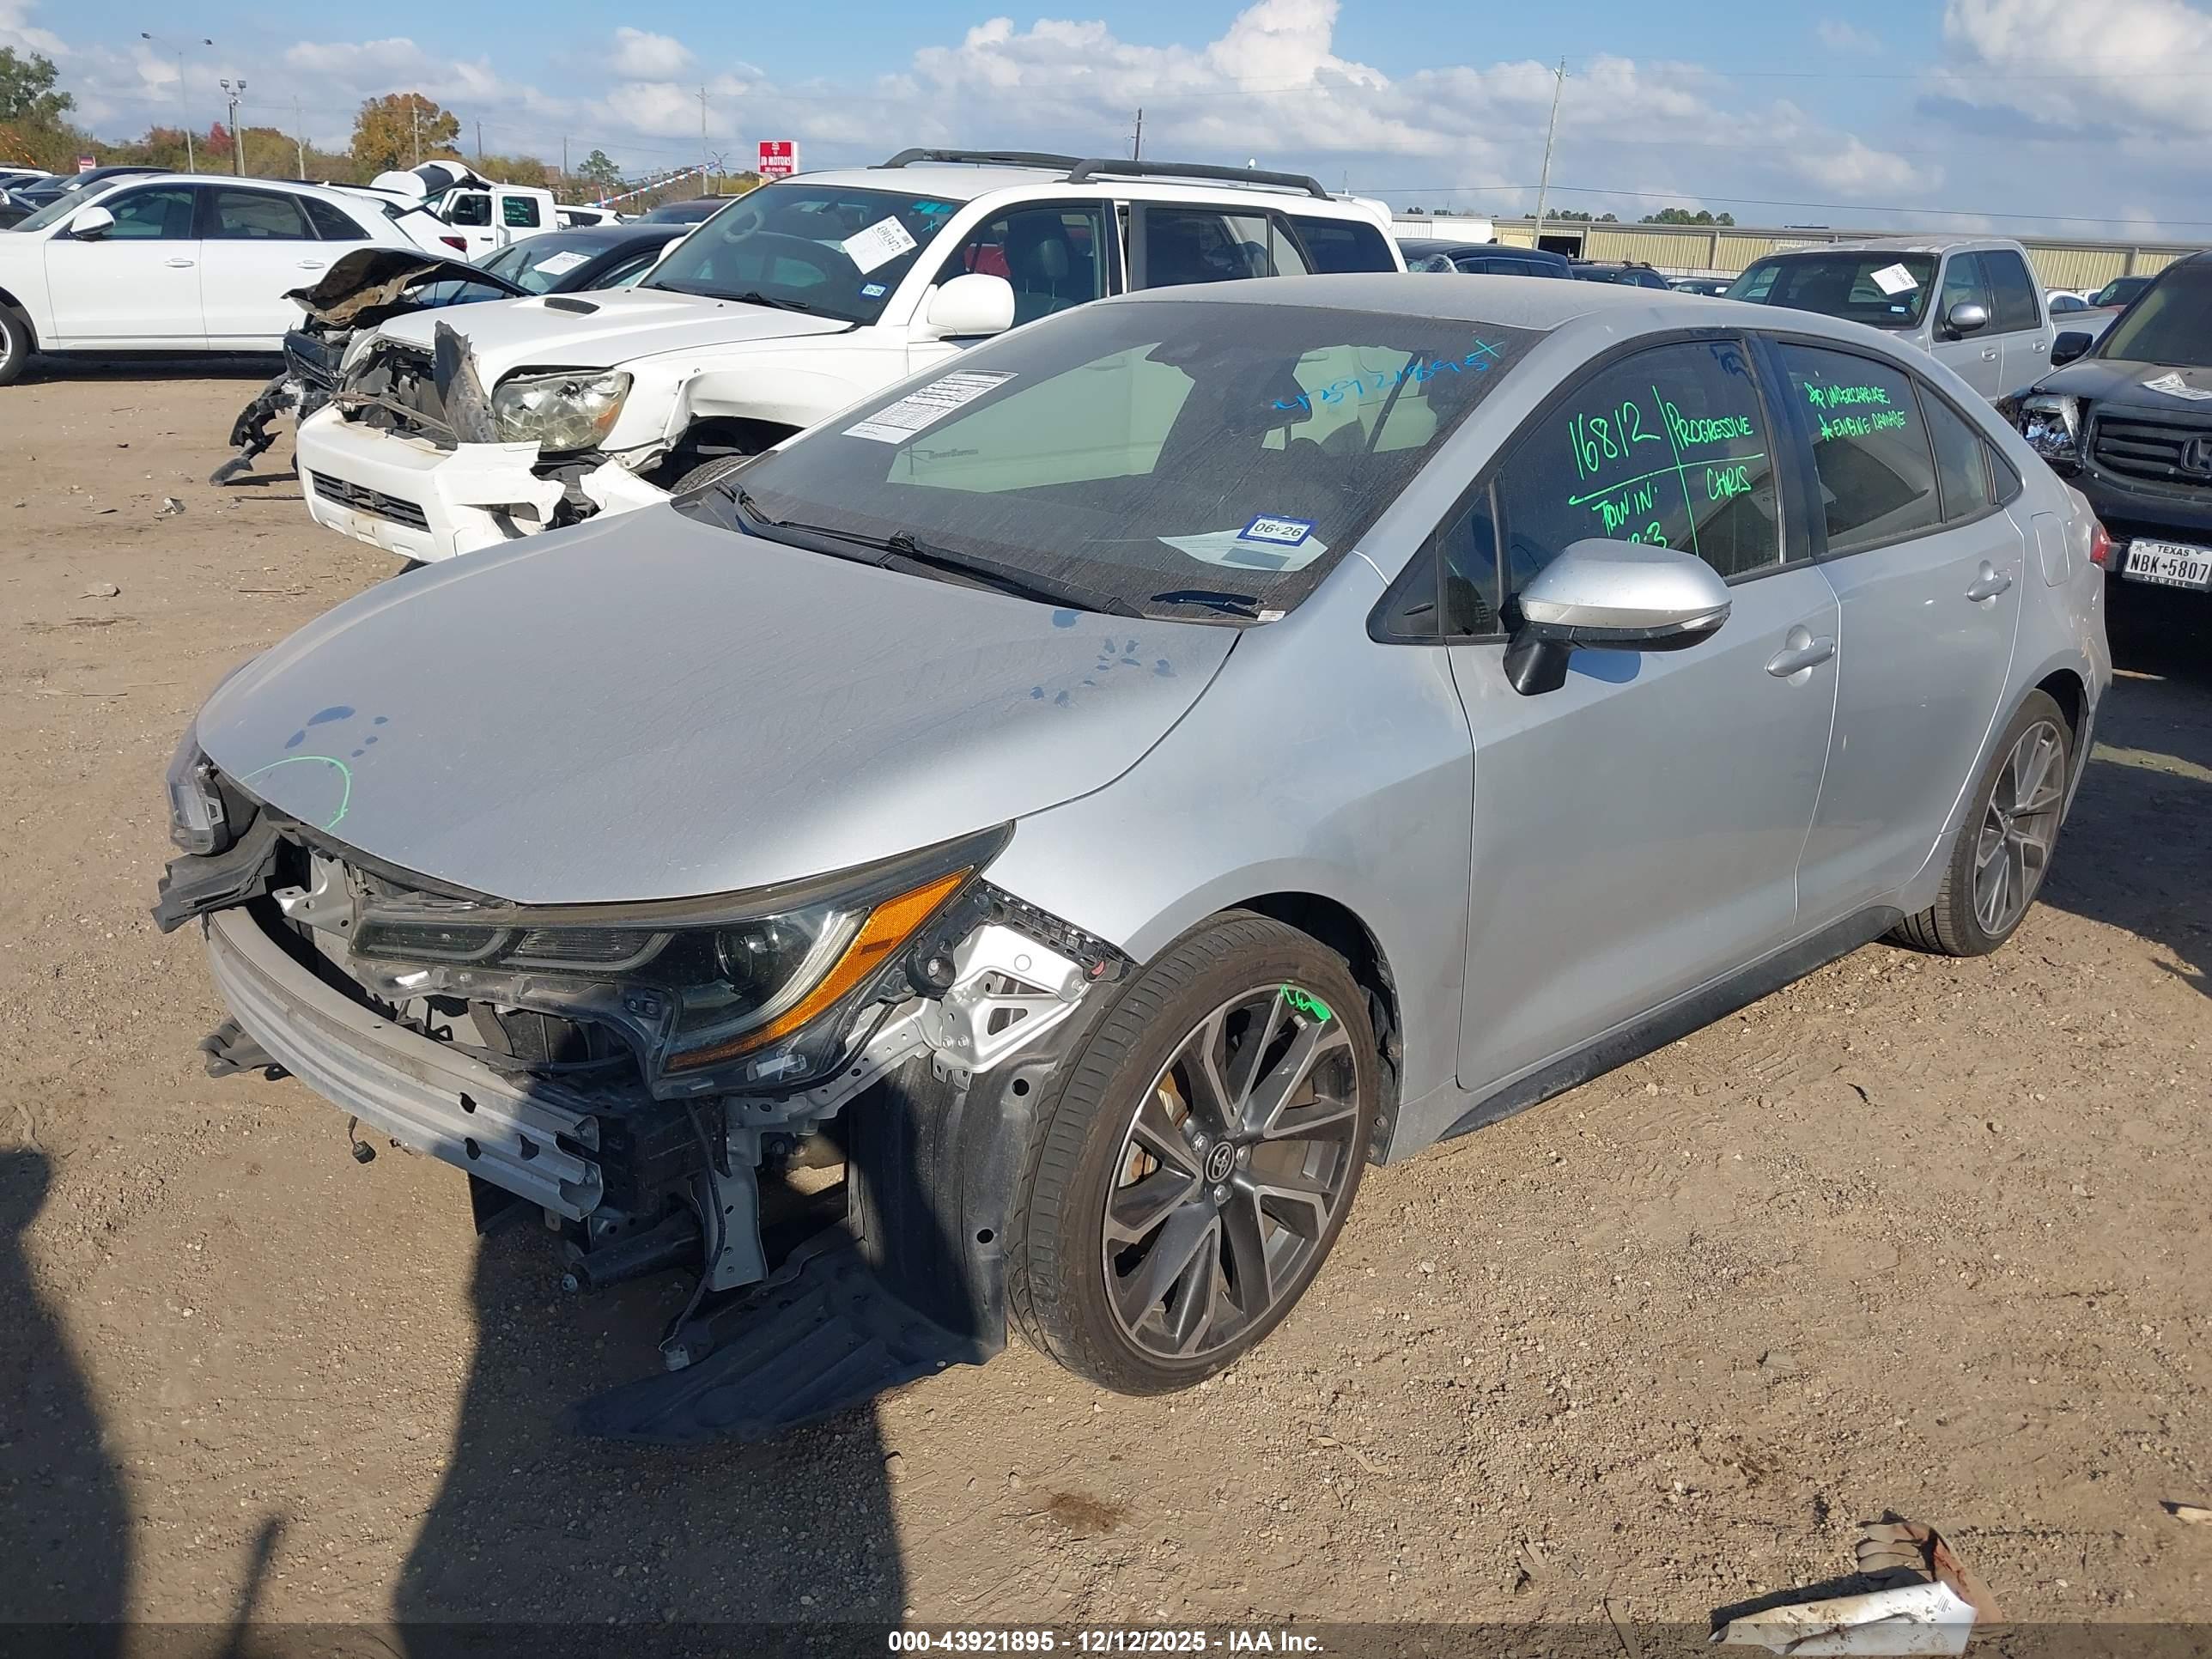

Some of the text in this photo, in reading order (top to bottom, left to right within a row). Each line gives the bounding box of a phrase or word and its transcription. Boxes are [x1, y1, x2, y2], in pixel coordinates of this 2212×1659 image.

[769, 155, 791, 166] MOTORS
[1666, 401, 1754, 451] PROGRESSIVE
[1832, 416, 1870, 437] ENGINE
[1569, 401, 1662, 481] 16812
[1706, 465, 1753, 501] CHRIS
[1591, 489, 1630, 537] TOW
[2157, 544, 2191, 557] TEXAS
[2142, 574, 2188, 587] SEWELL
